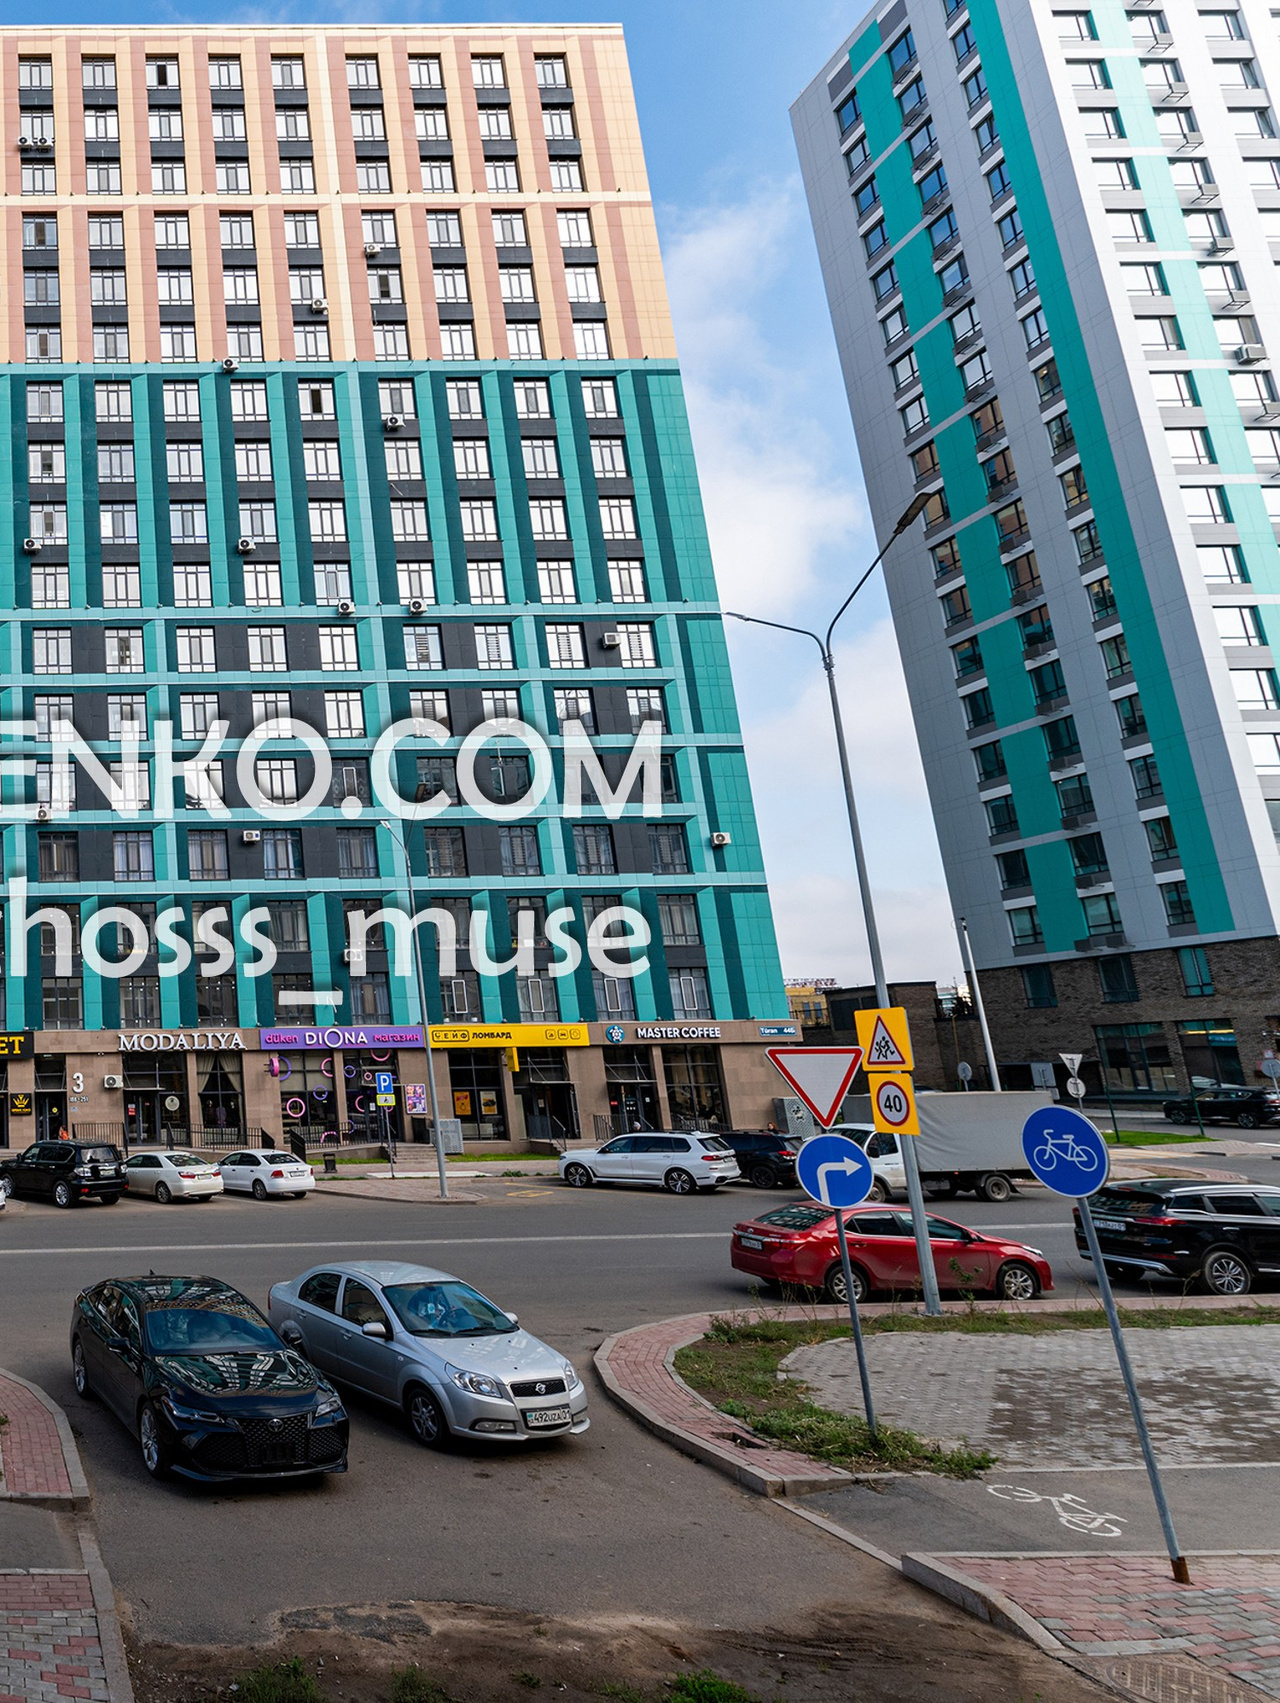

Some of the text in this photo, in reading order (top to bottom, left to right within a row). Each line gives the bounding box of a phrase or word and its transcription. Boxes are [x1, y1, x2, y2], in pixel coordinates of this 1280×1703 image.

[118, 1032, 247, 1051] MODALIYA
[265, 1028, 420, 1048] düken DIONA магазин
[472, 1032, 512, 1040] ЛОМБАРД
[637, 1027, 722, 1039] MASTER COFFEE
[72, 1072, 84, 1093] 3
[884, 1094, 903, 1113] 40
